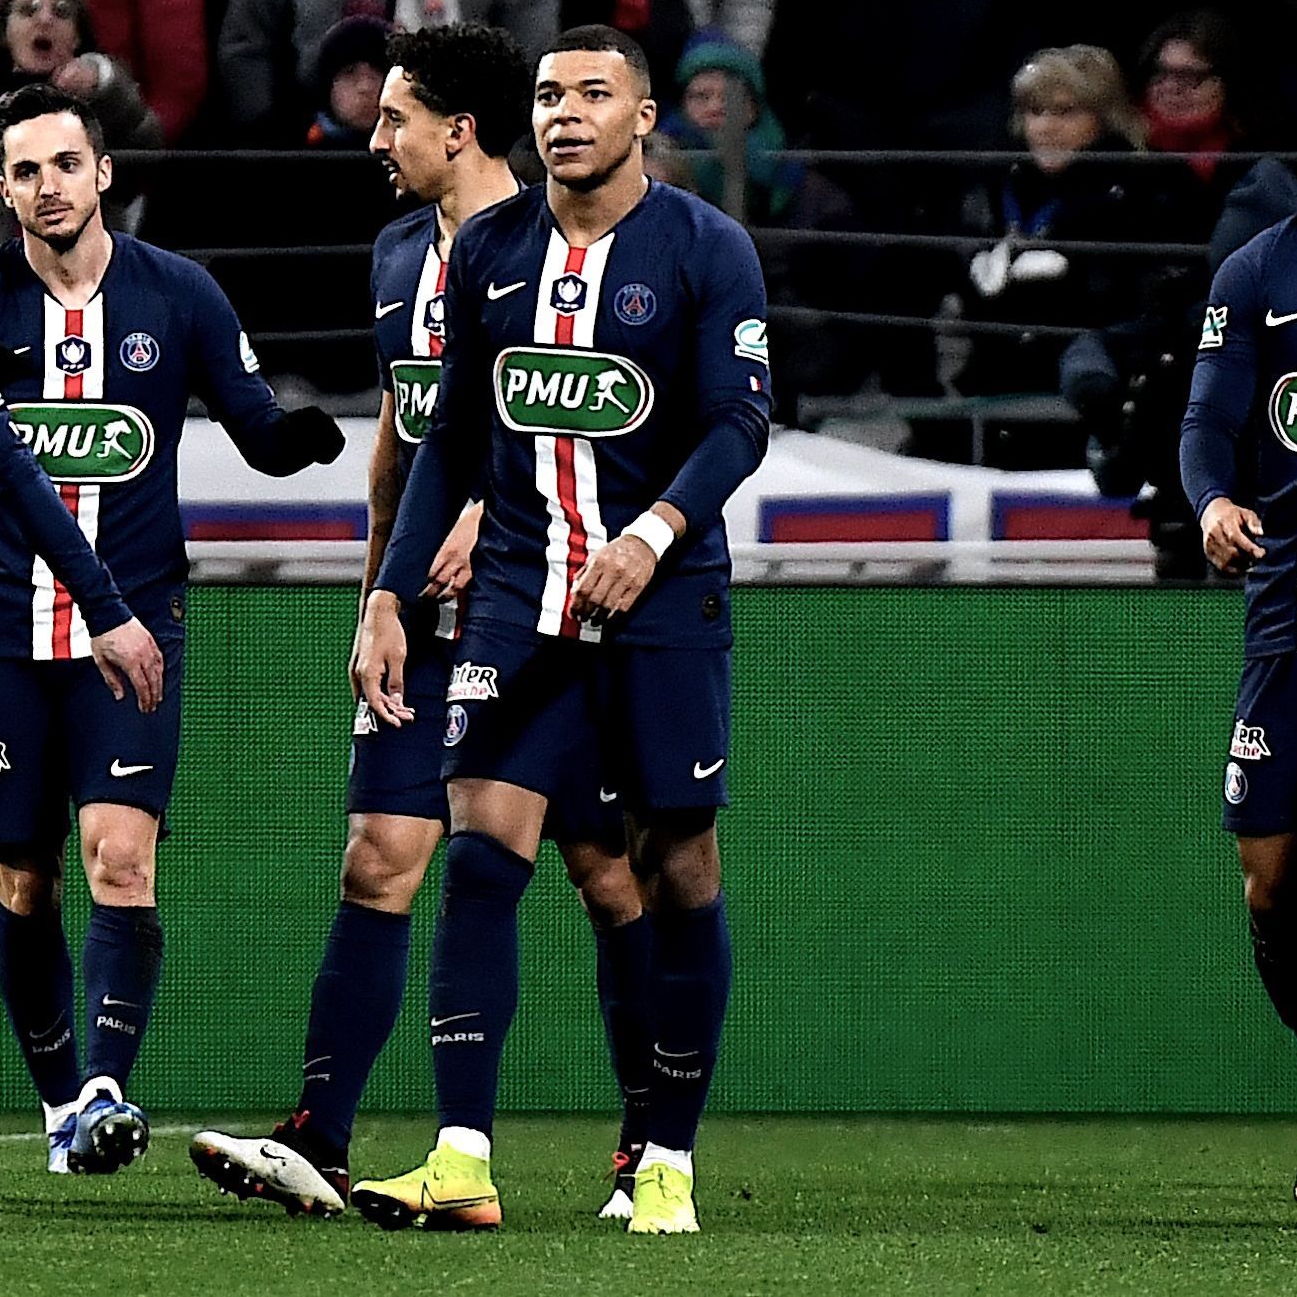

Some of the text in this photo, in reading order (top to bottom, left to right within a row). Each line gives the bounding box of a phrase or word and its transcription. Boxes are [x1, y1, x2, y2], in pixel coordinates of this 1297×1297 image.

[505, 367, 589, 410] PMU
[397, 381, 441, 418] PM
[96, 1015, 137, 1036] PARIS
[430, 1032, 486, 1047] PARIS
[653, 1058, 703, 1079] PARIS
